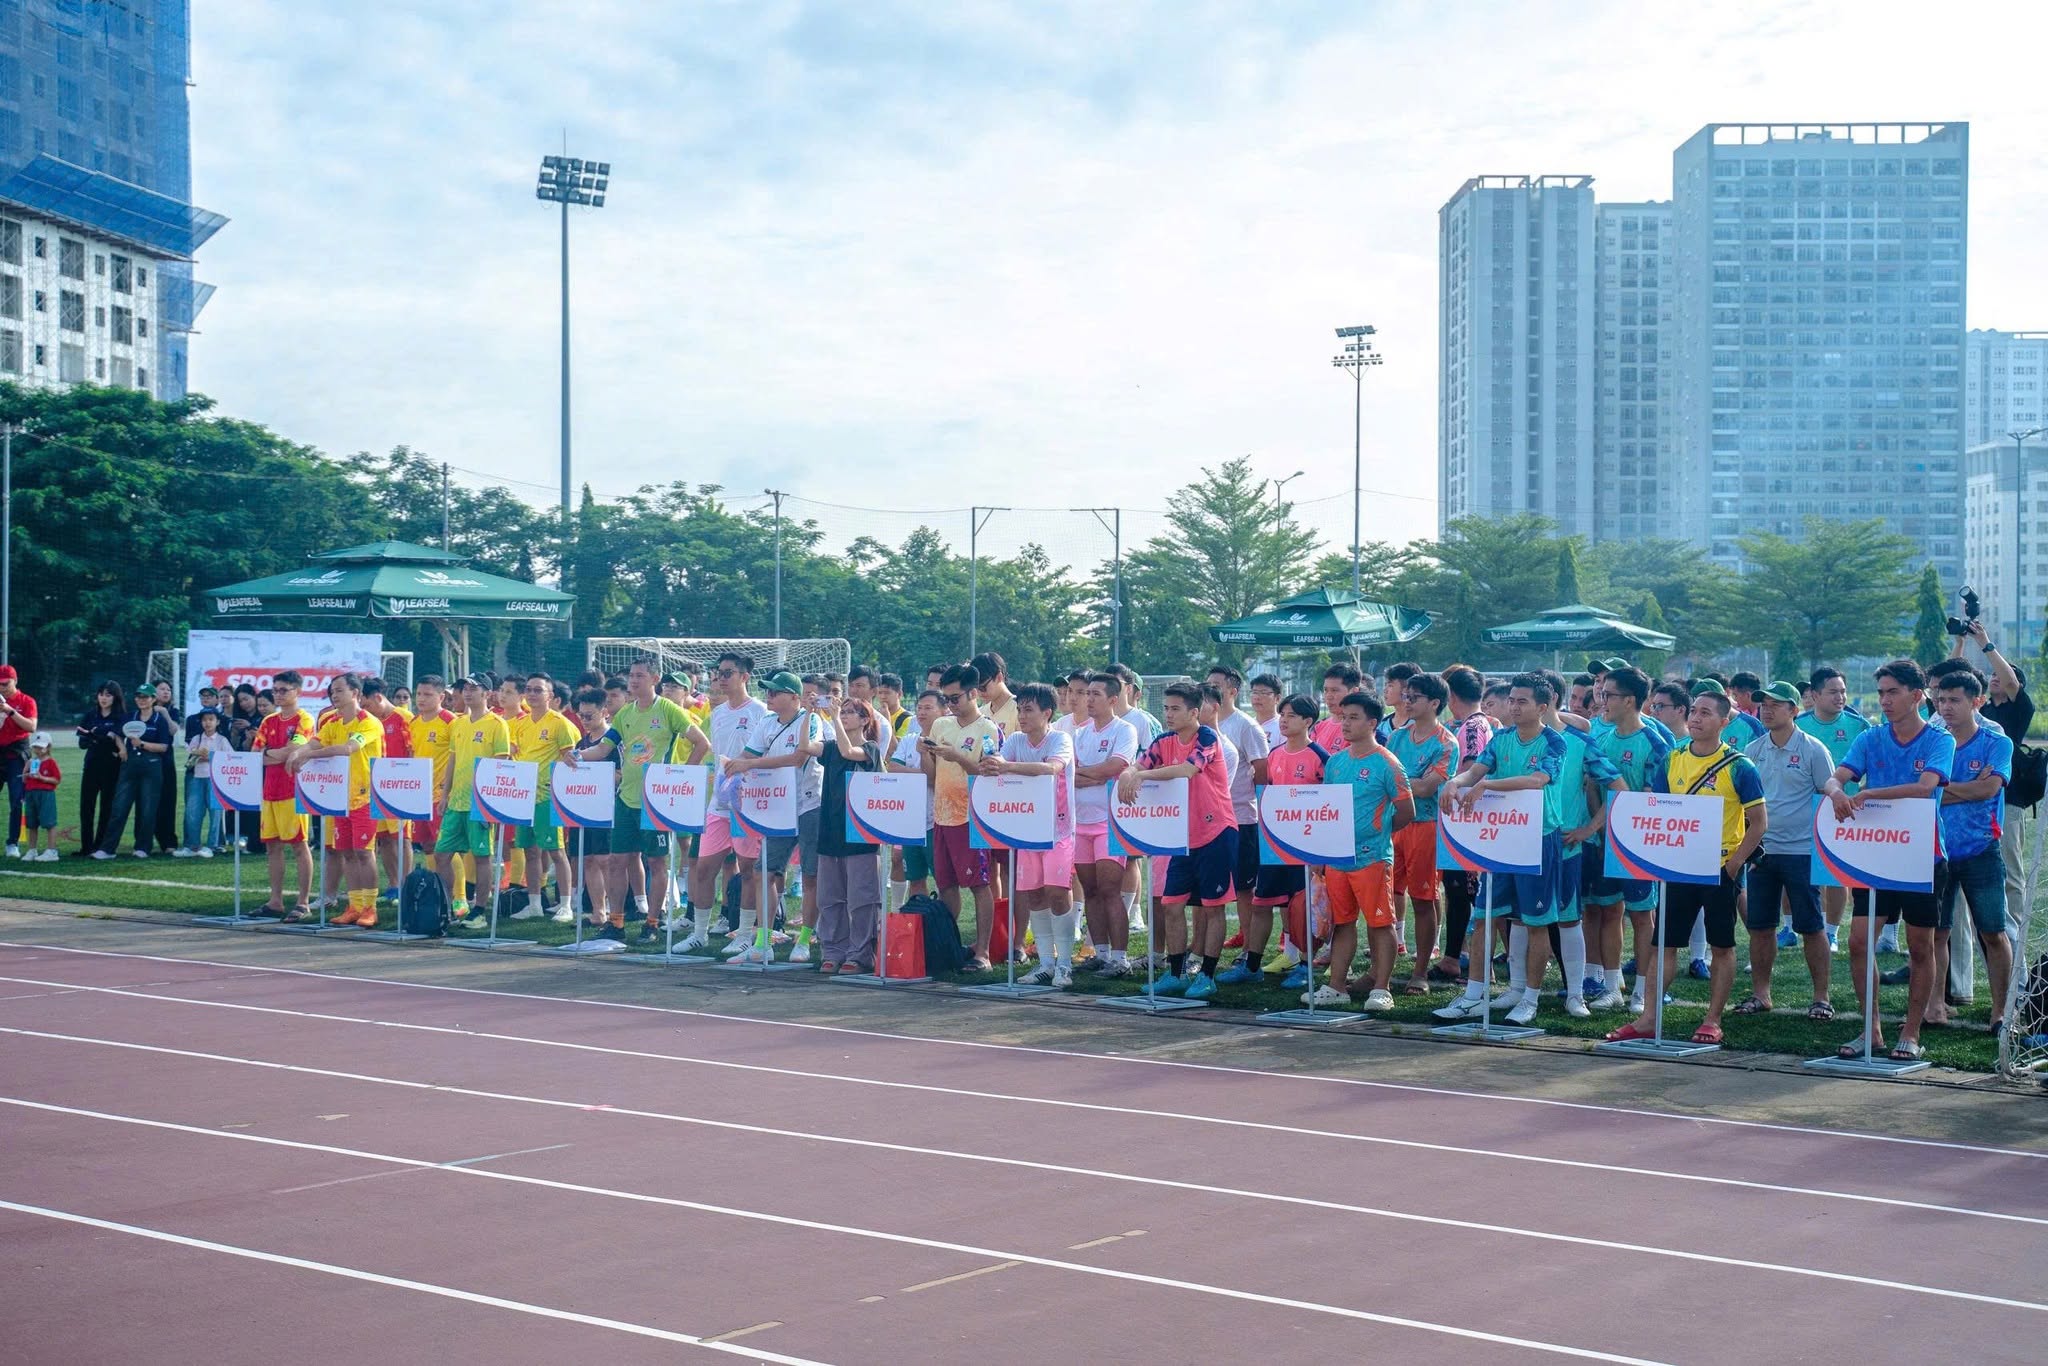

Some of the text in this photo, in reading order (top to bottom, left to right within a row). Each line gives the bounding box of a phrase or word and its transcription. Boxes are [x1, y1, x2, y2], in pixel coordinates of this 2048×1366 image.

[307, 598, 356, 609] LEAFSEAL.VN
[405, 598, 450, 609] LEAFSEAL
[506, 601, 559, 613] LEAFSEAL.VN
[221, 765, 249, 776] GLOBAL
[227, 776, 242, 785] CT3
[301, 771, 316, 783] VĂN
[495, 775, 517, 787] TSLA
[319, 785, 325, 794] 2
[379, 779, 421, 790] NEWTECH
[565, 784, 597, 796] MIZUKI
[651, 781, 695, 796] TAM KIẾM
[480, 785, 530, 800] FULBRIGHT
[773, 786, 787, 798] CƯ
[669, 797, 675, 807] 1
[756, 800, 768, 811] C3
[867, 799, 905, 811] BASON
[988, 802, 1035, 814] BLANCA
[1116, 805, 1180, 818] SONG LONG
[1275, 804, 1339, 822] TAM KIẾM
[1487, 808, 1529, 826] QUÂN
[1303, 824, 1312, 836] 2
[1631, 816, 1700, 833] THE ONE
[656, 834, 666, 847] 13
[1479, 828, 1499, 841] 2V
[1643, 833, 1685, 848] HPLA
[1834, 827, 1911, 844] PAIHONG
